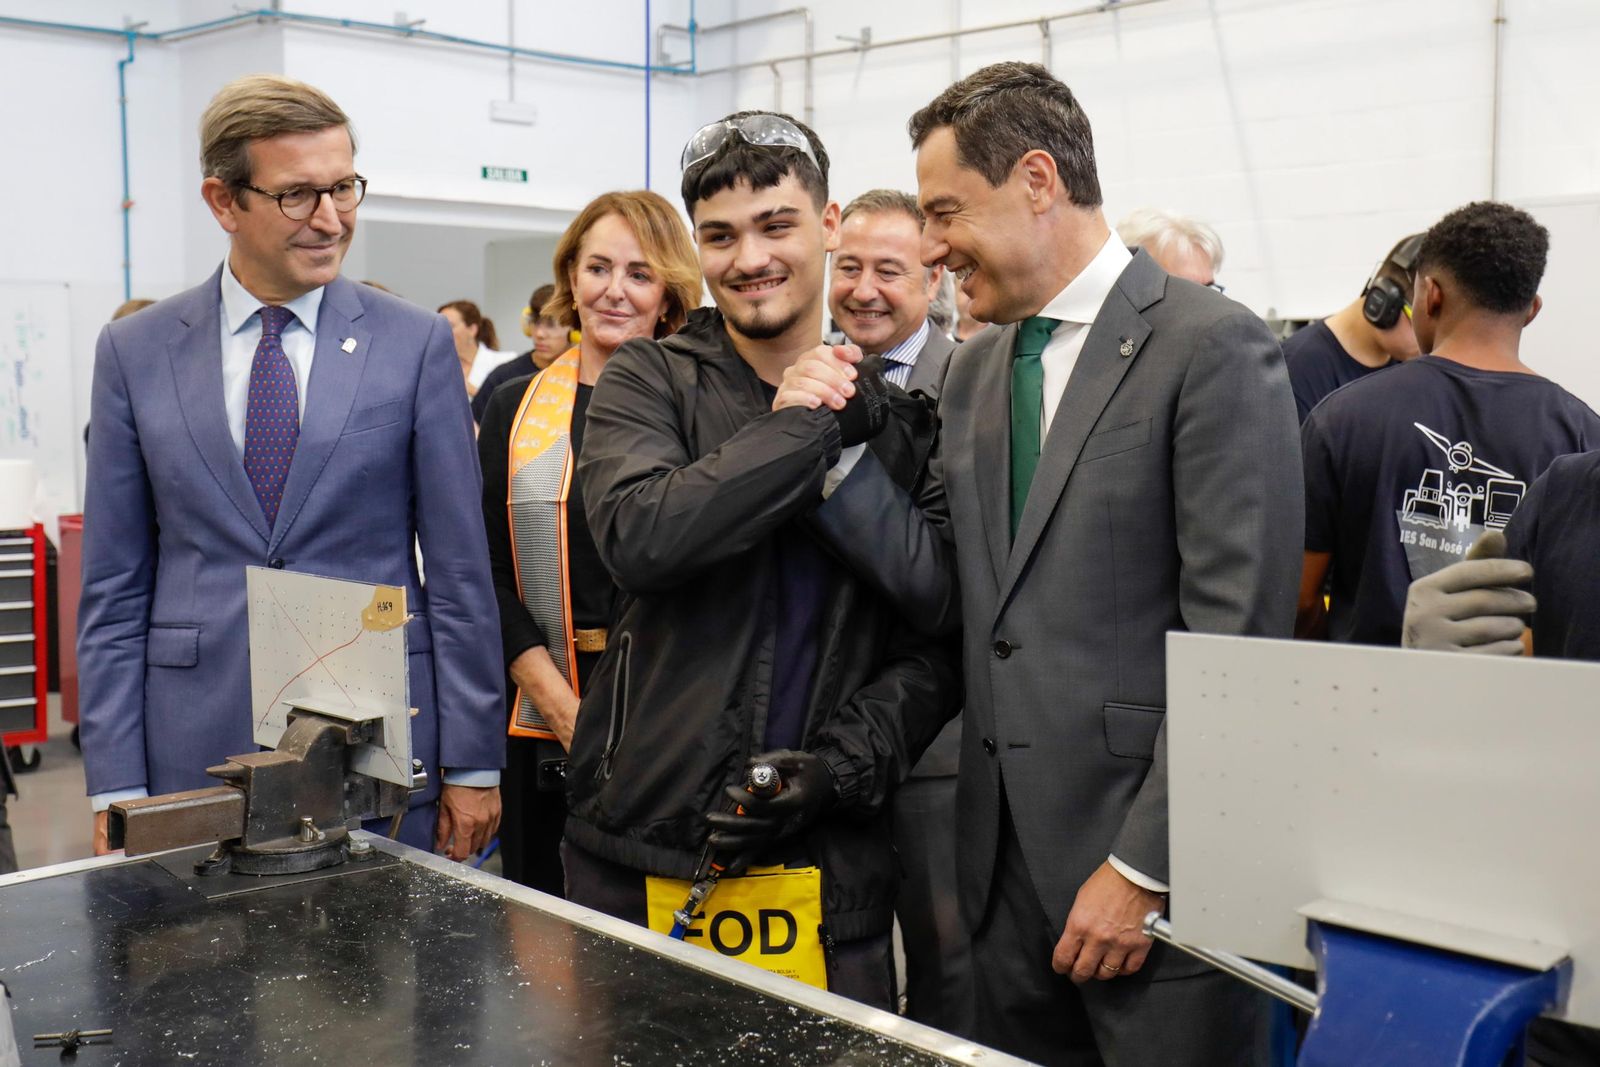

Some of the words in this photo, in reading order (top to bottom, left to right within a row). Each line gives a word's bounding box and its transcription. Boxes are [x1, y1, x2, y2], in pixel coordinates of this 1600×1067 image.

[486, 167, 523, 182] SALIDA
[1400, 530, 1417, 545] IES
[1419, 533, 1438, 549] San
[1439, 538, 1463, 555] José
